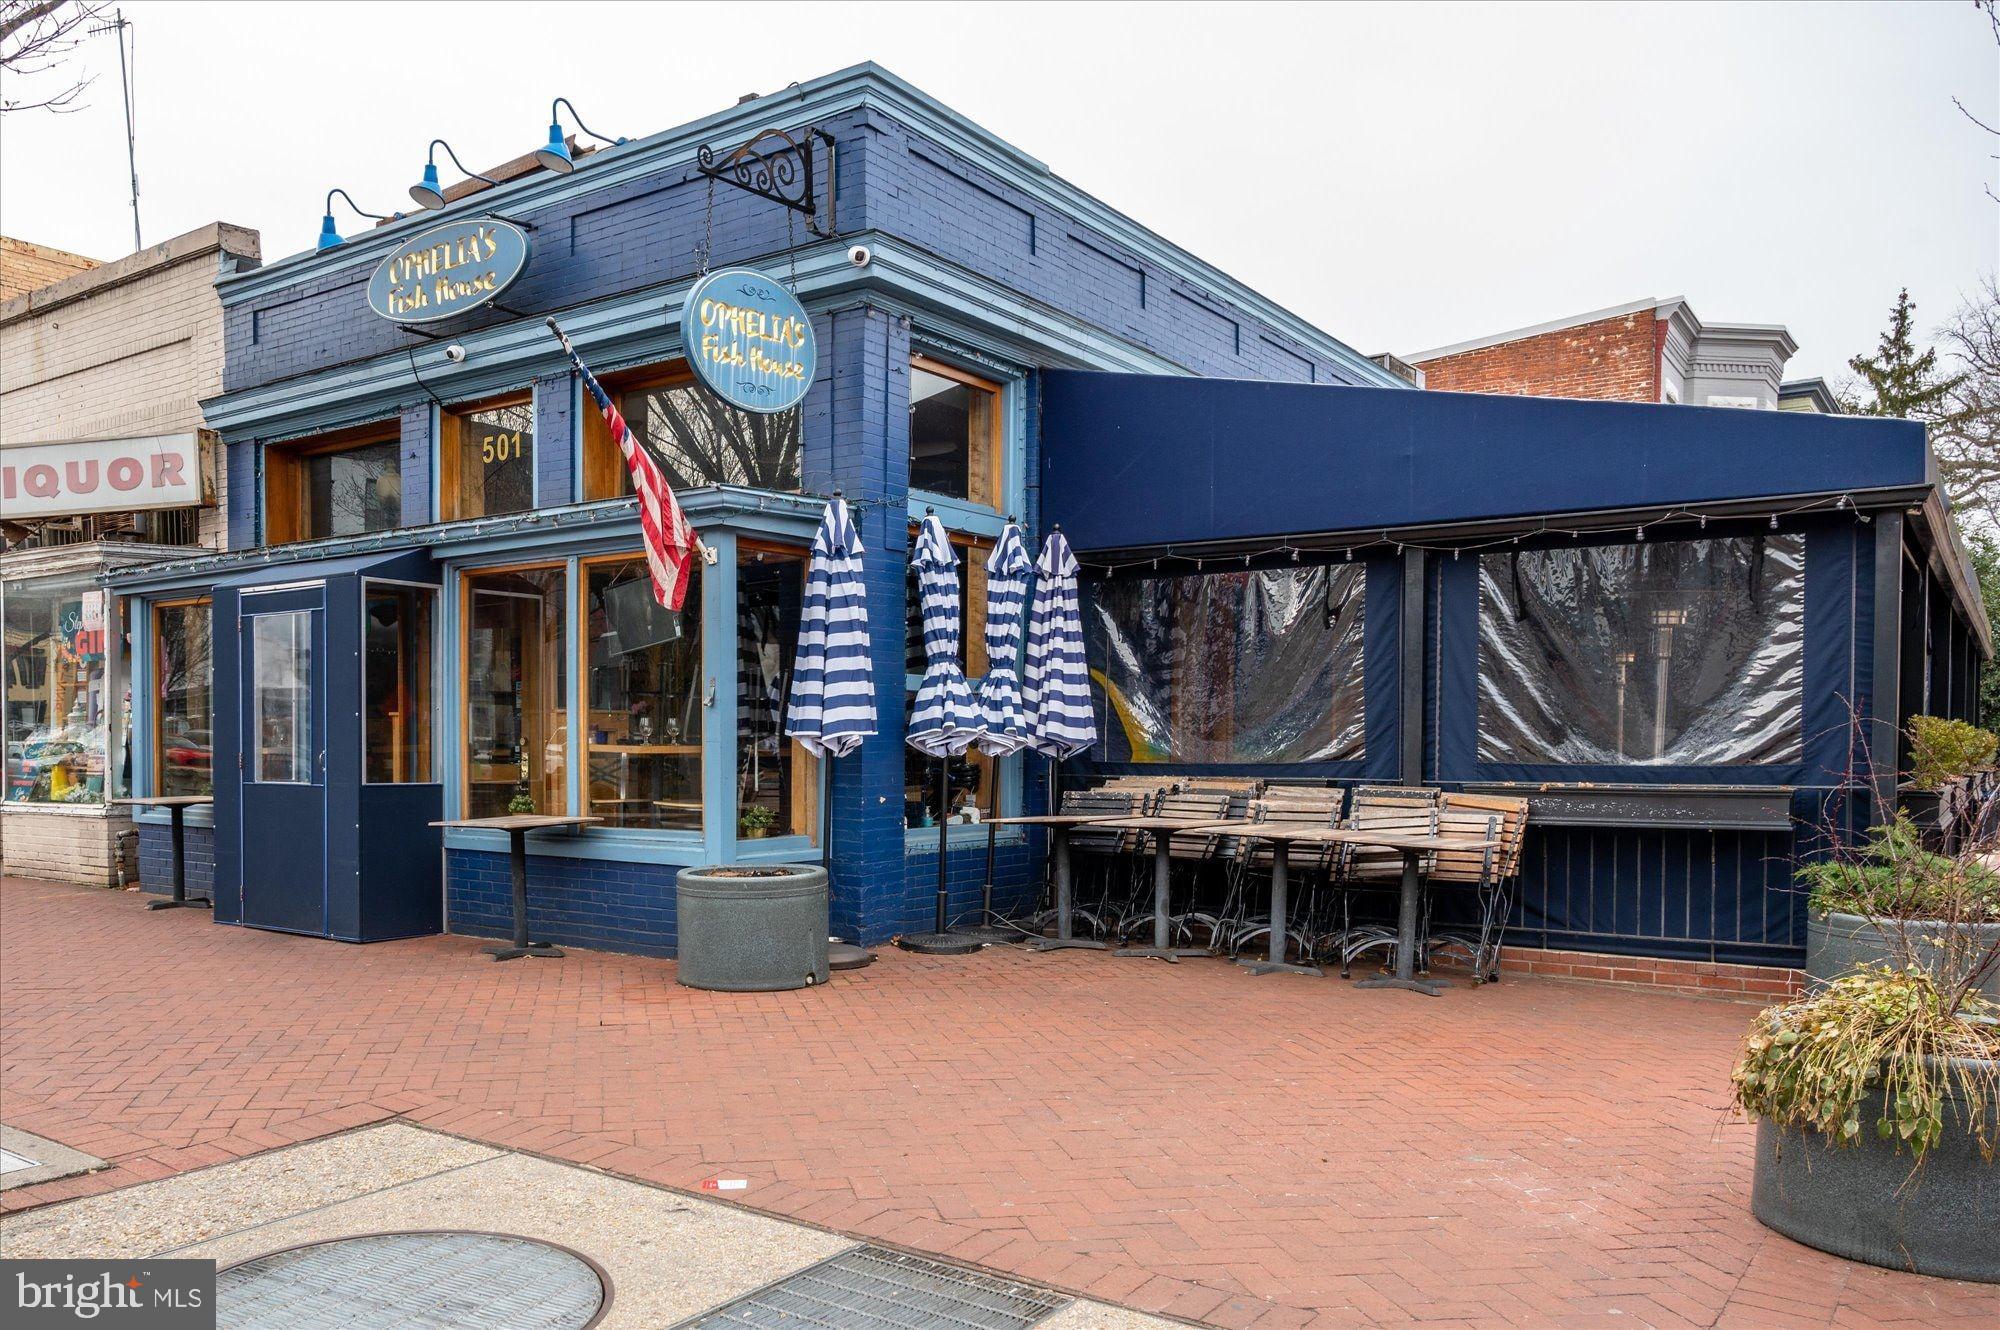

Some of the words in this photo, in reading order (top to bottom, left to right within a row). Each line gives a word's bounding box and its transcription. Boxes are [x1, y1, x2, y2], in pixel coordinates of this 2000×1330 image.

[389, 225, 497, 285] OPHELIA'S
[388, 282, 429, 315] Fish
[435, 270, 497, 306] House
[701, 297, 805, 350] OPHELIA'S
[702, 333, 747, 368] Fish
[749, 345, 806, 381] House
[482, 431, 521, 464] 501
